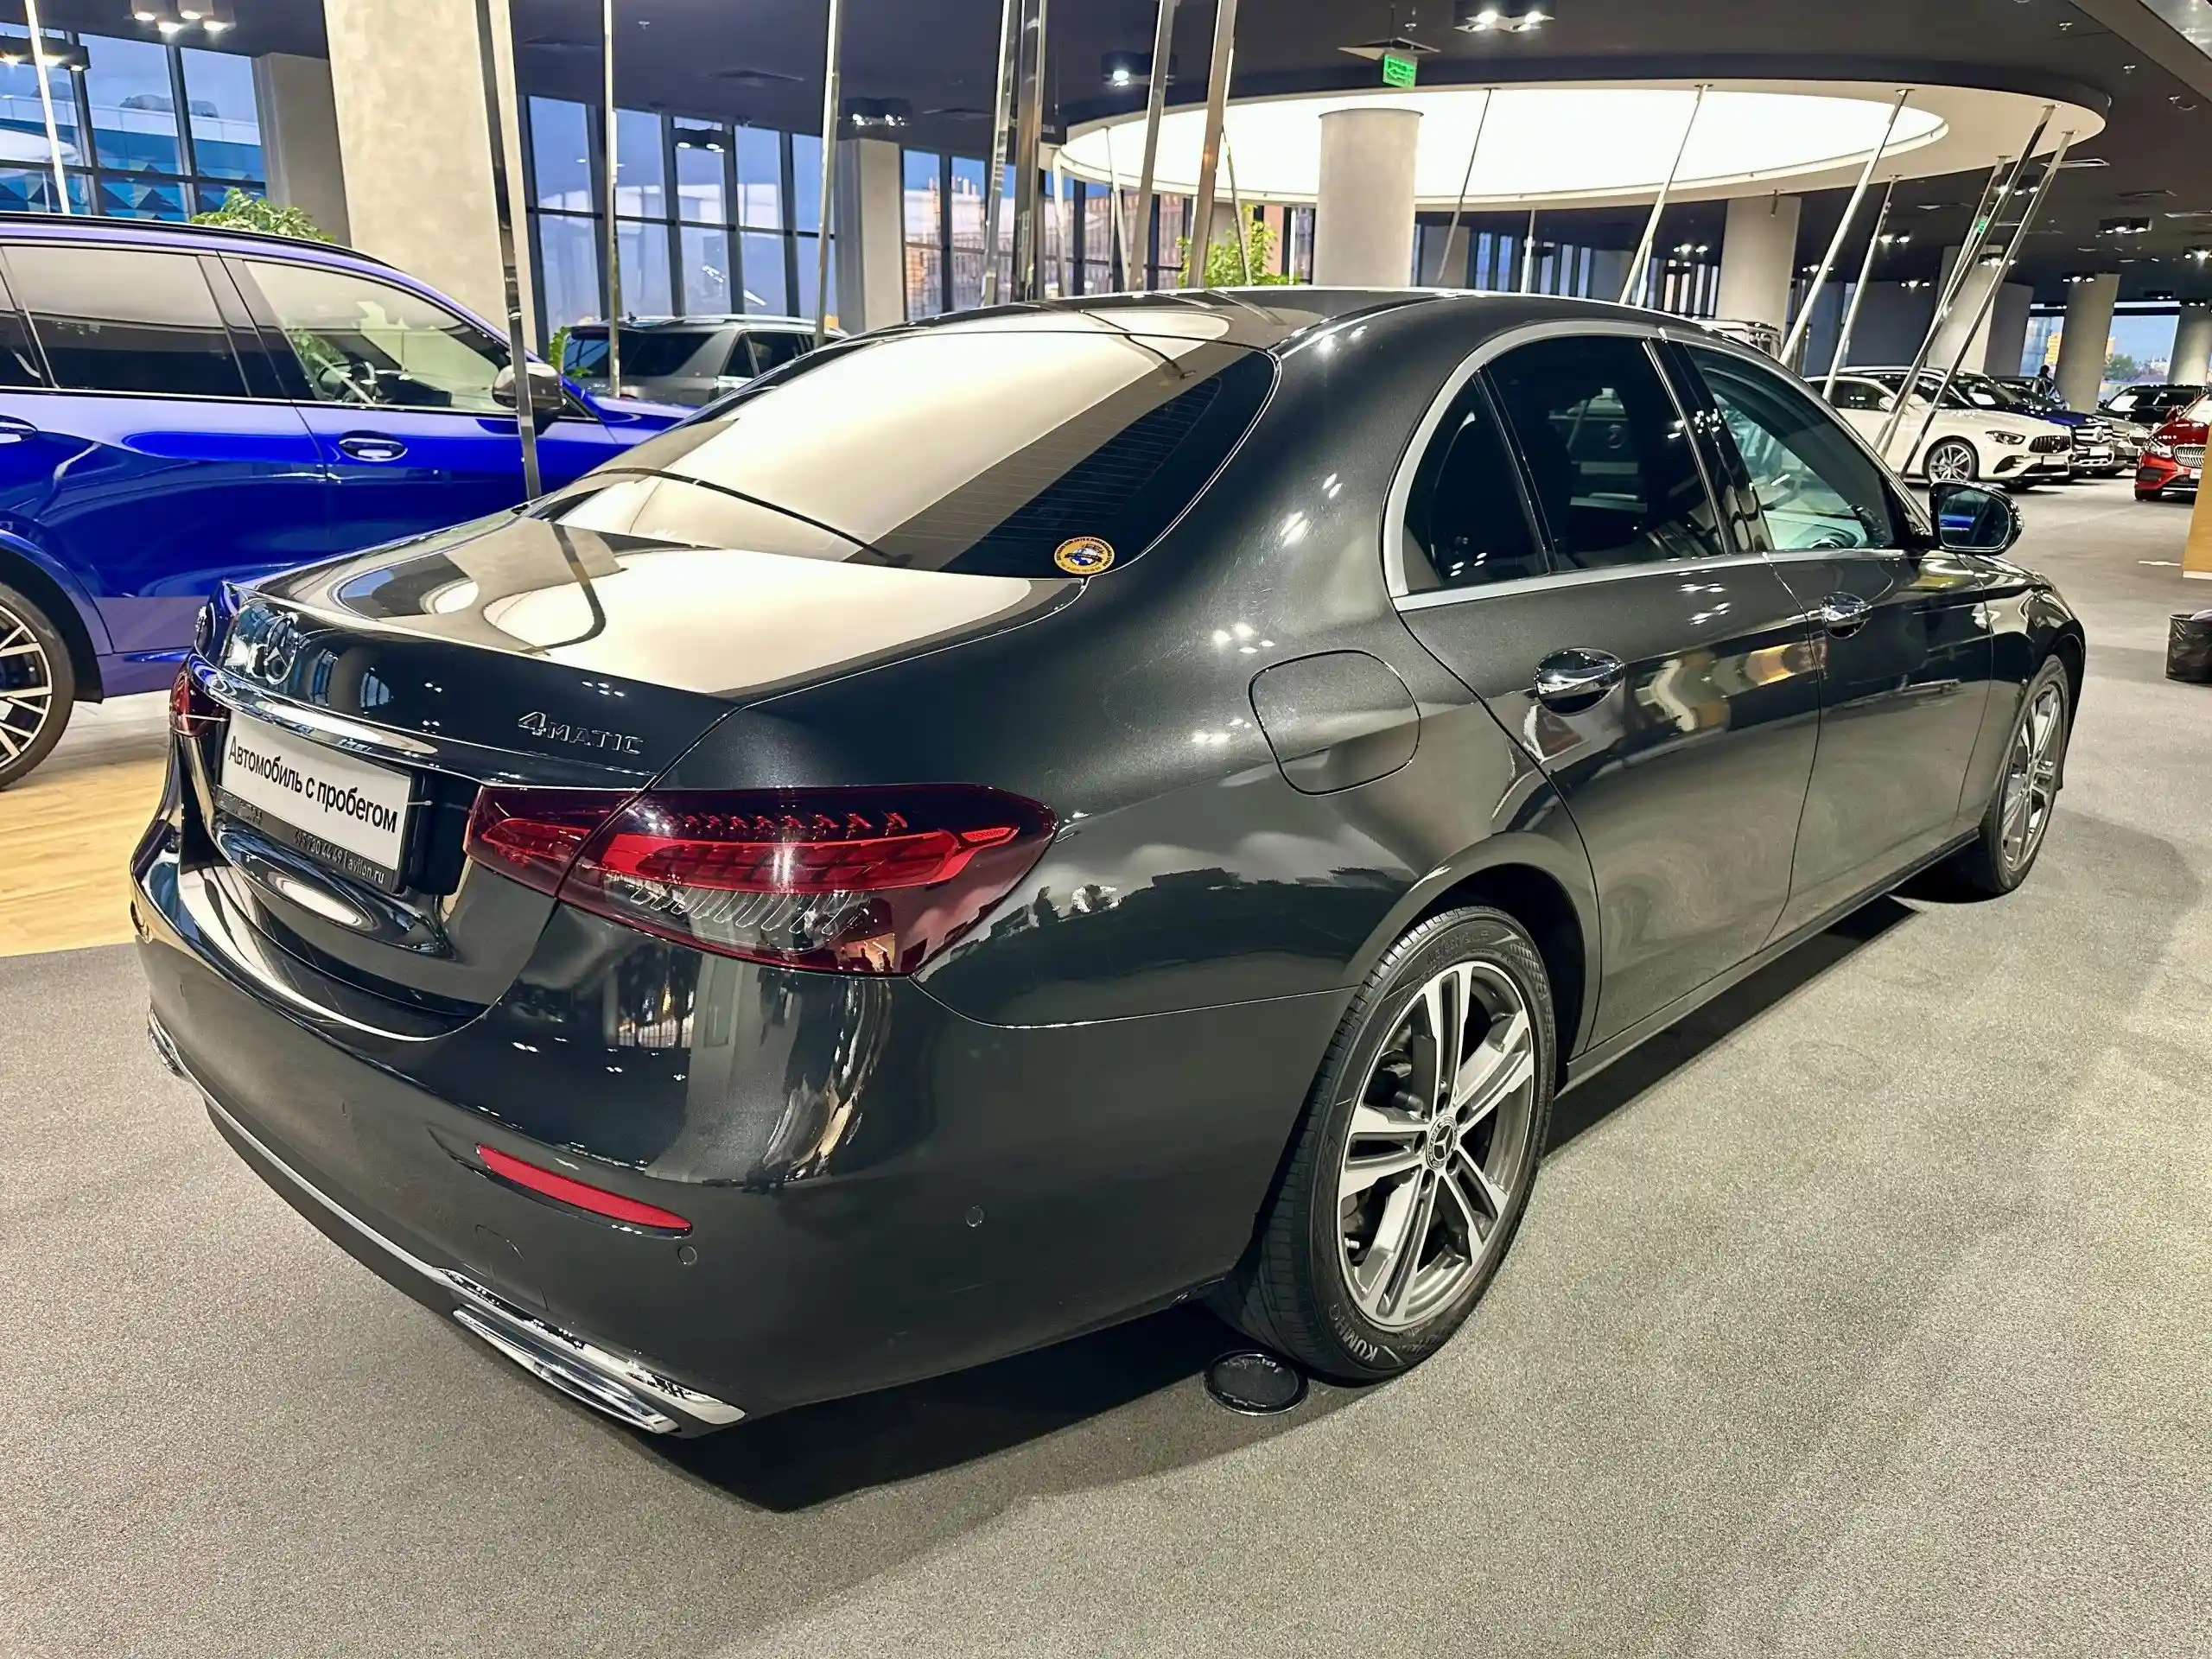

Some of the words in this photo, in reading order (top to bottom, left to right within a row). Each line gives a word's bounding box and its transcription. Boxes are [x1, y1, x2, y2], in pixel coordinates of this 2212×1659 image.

[518, 711, 644, 754] 4MATIC
[228, 735, 302, 793] Автомобиль
[305, 777, 315, 798] с
[316, 781, 398, 833] пробегом
[307, 836, 321, 855] 730
[348, 858, 385, 885] avilon.ru
